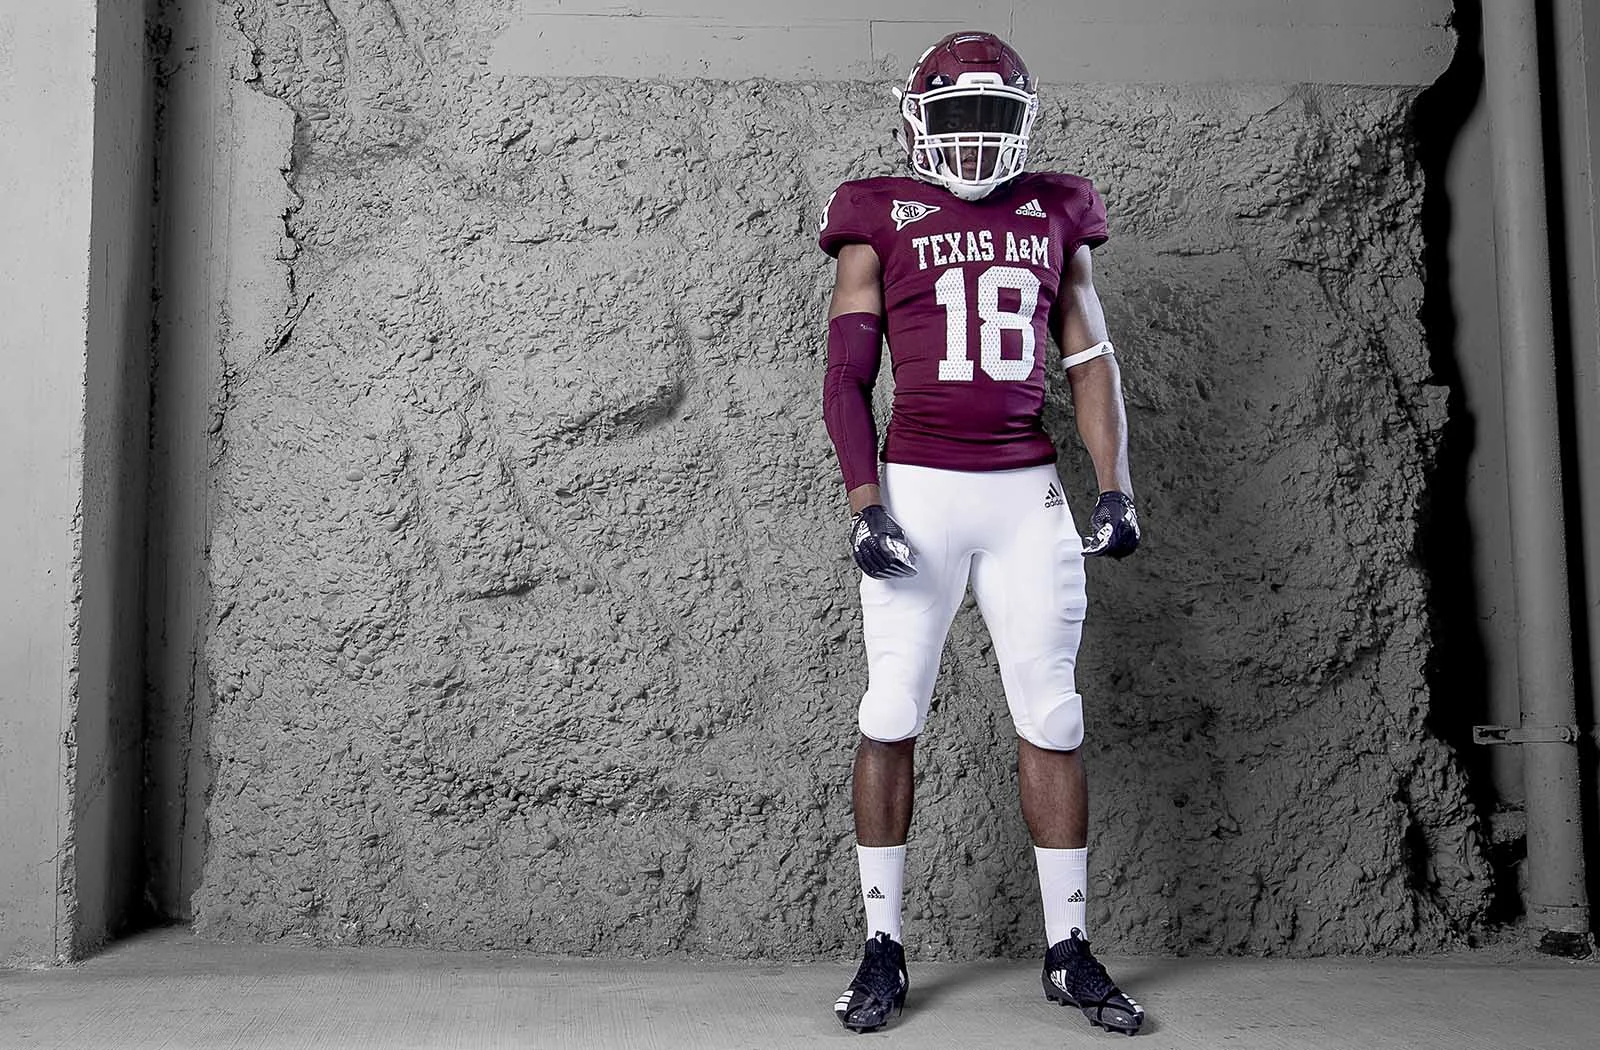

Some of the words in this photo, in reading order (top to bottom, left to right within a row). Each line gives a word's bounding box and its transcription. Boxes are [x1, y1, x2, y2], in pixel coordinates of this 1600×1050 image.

[903, 206, 920, 218] SEC
[1015, 208, 1047, 218] adidas
[912, 230, 995, 270] TEXAS
[1005, 231, 1050, 269] A&M
[934, 265, 1042, 382] 18
